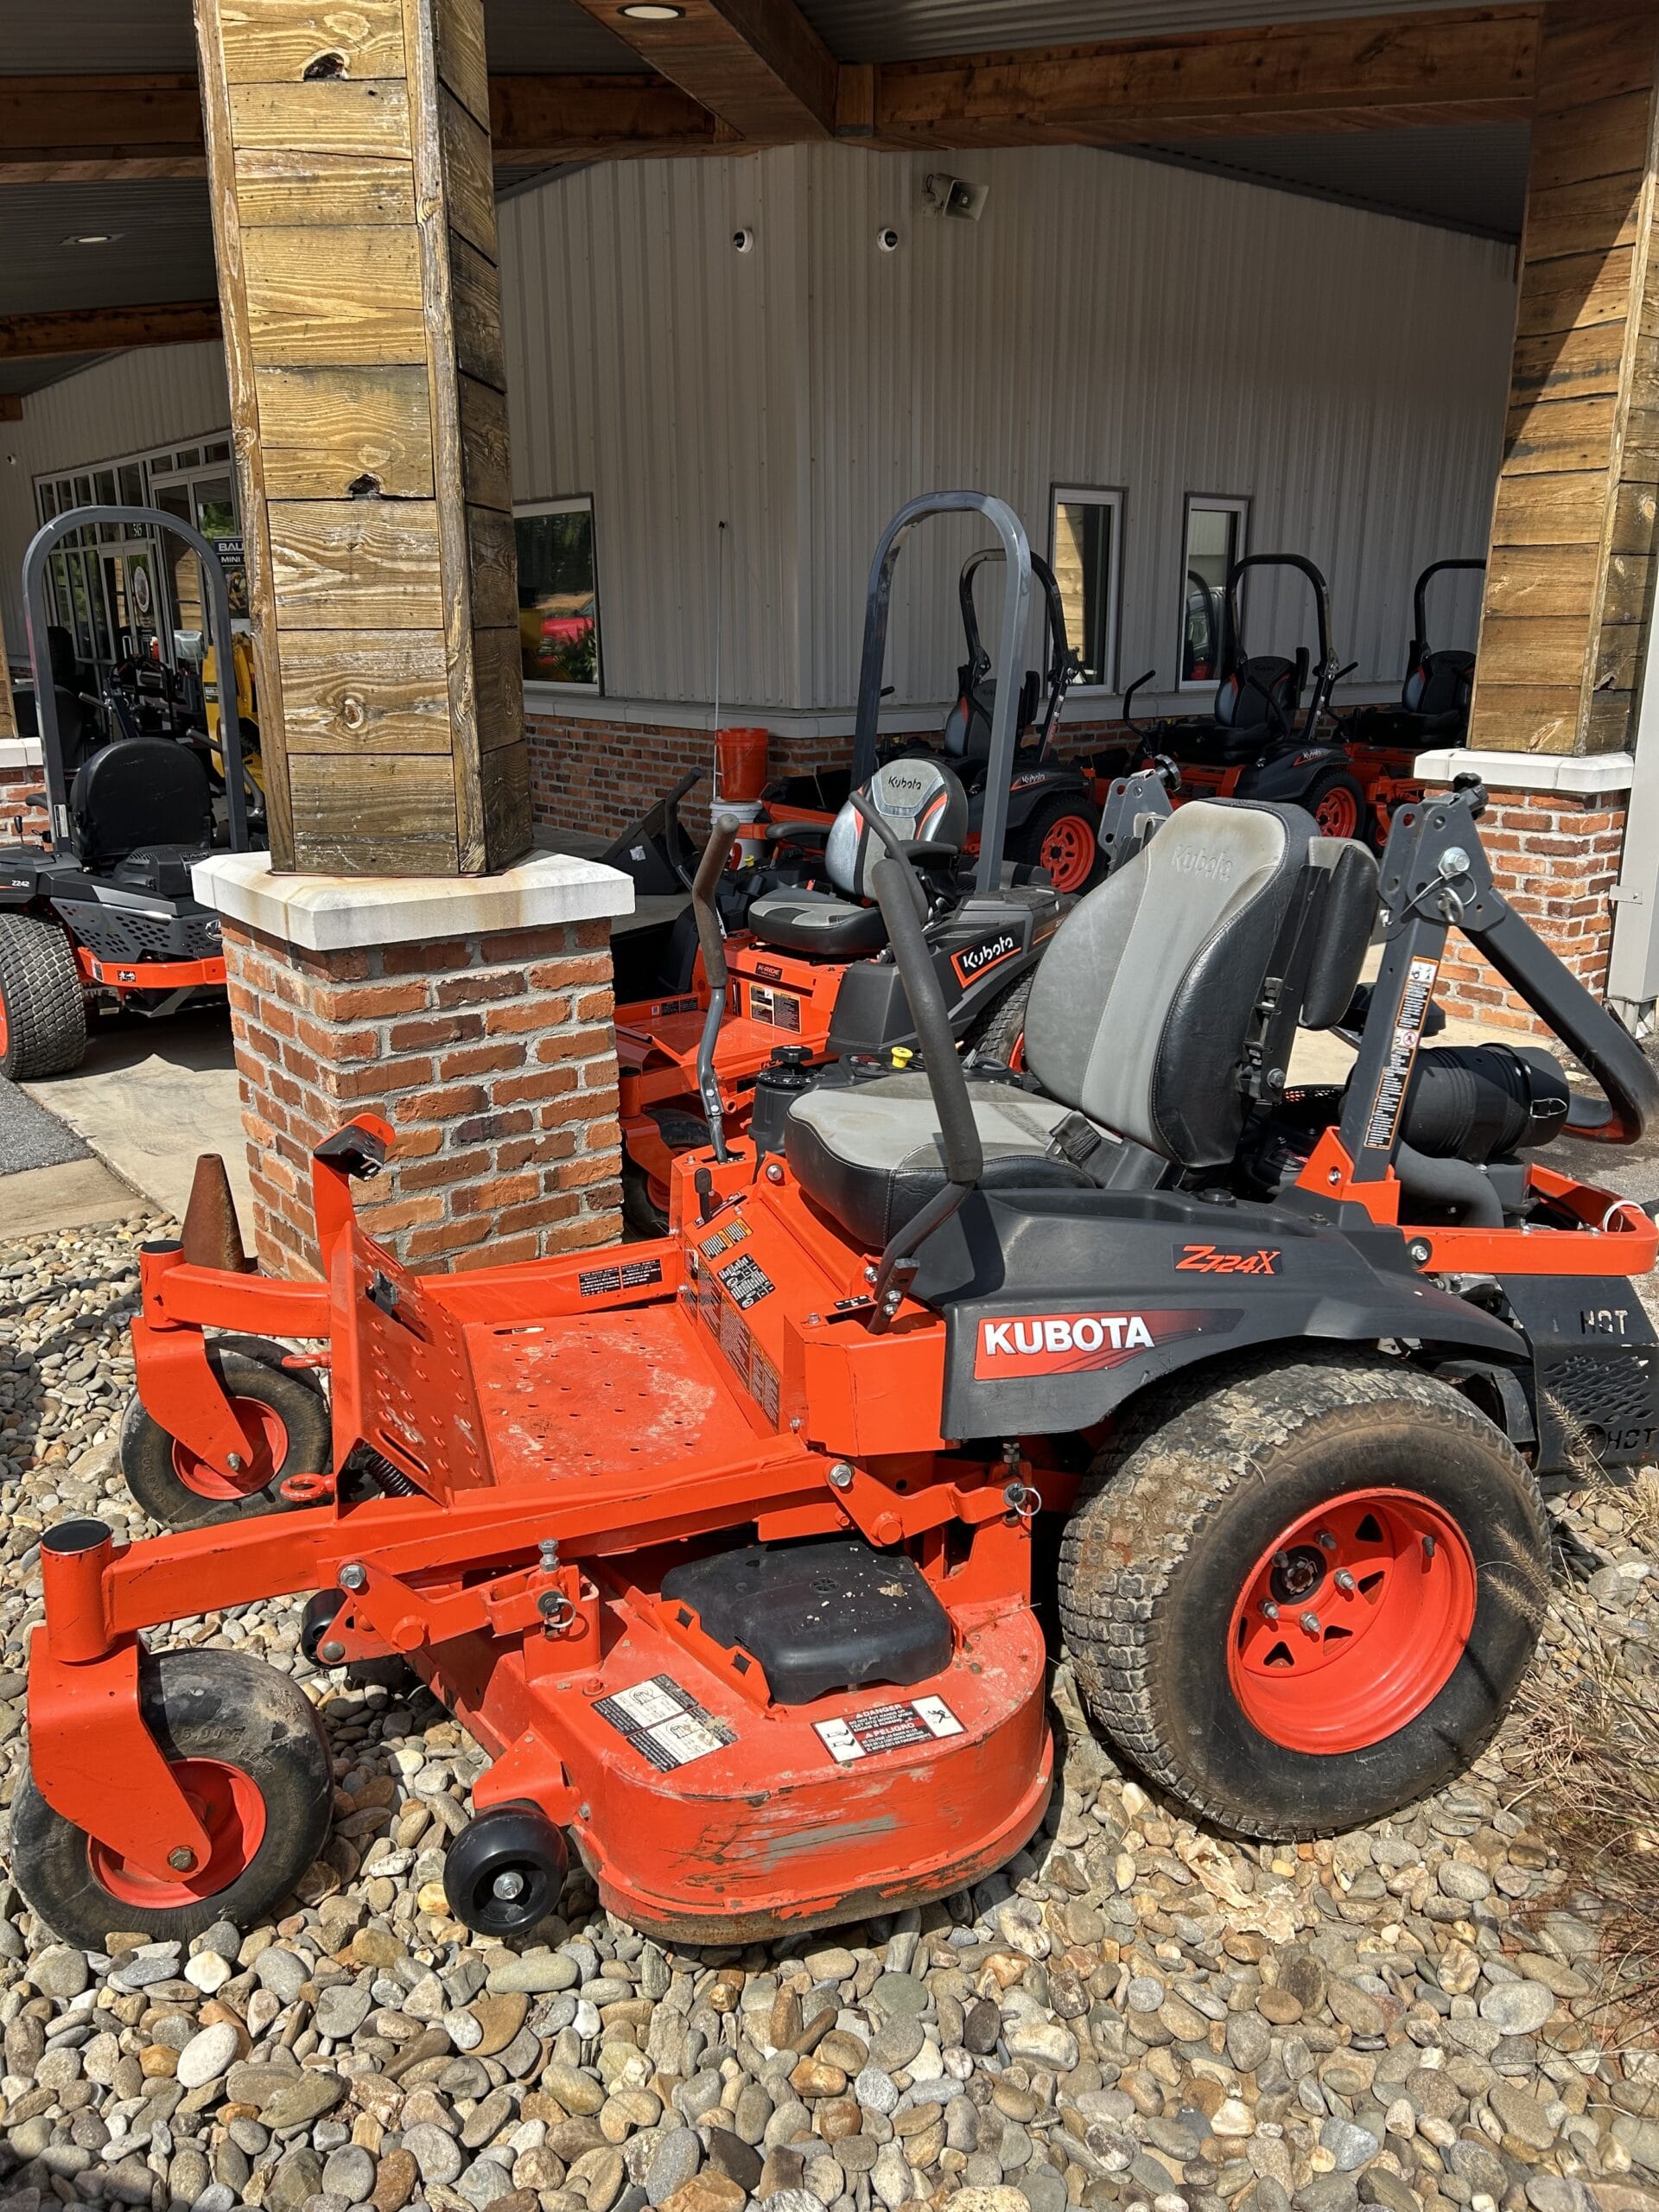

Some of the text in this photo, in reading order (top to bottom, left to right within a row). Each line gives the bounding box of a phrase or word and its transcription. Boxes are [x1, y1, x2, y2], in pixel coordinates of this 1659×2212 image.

[887, 775, 922, 791] Kubota
[1021, 772, 1046, 784] Kubota
[1170, 843, 1233, 882] Kubota
[962, 936, 1014, 969] Kubota
[1175, 1245, 1281, 1274] Z724X
[1580, 1309, 1629, 1335] HOT
[984, 1316, 1155, 1356] KUBOTA
[1605, 1427, 1658, 1451] HOT
[862, 1704, 902, 1717] DANGER
[873, 1723, 915, 1736] PELIGRO
